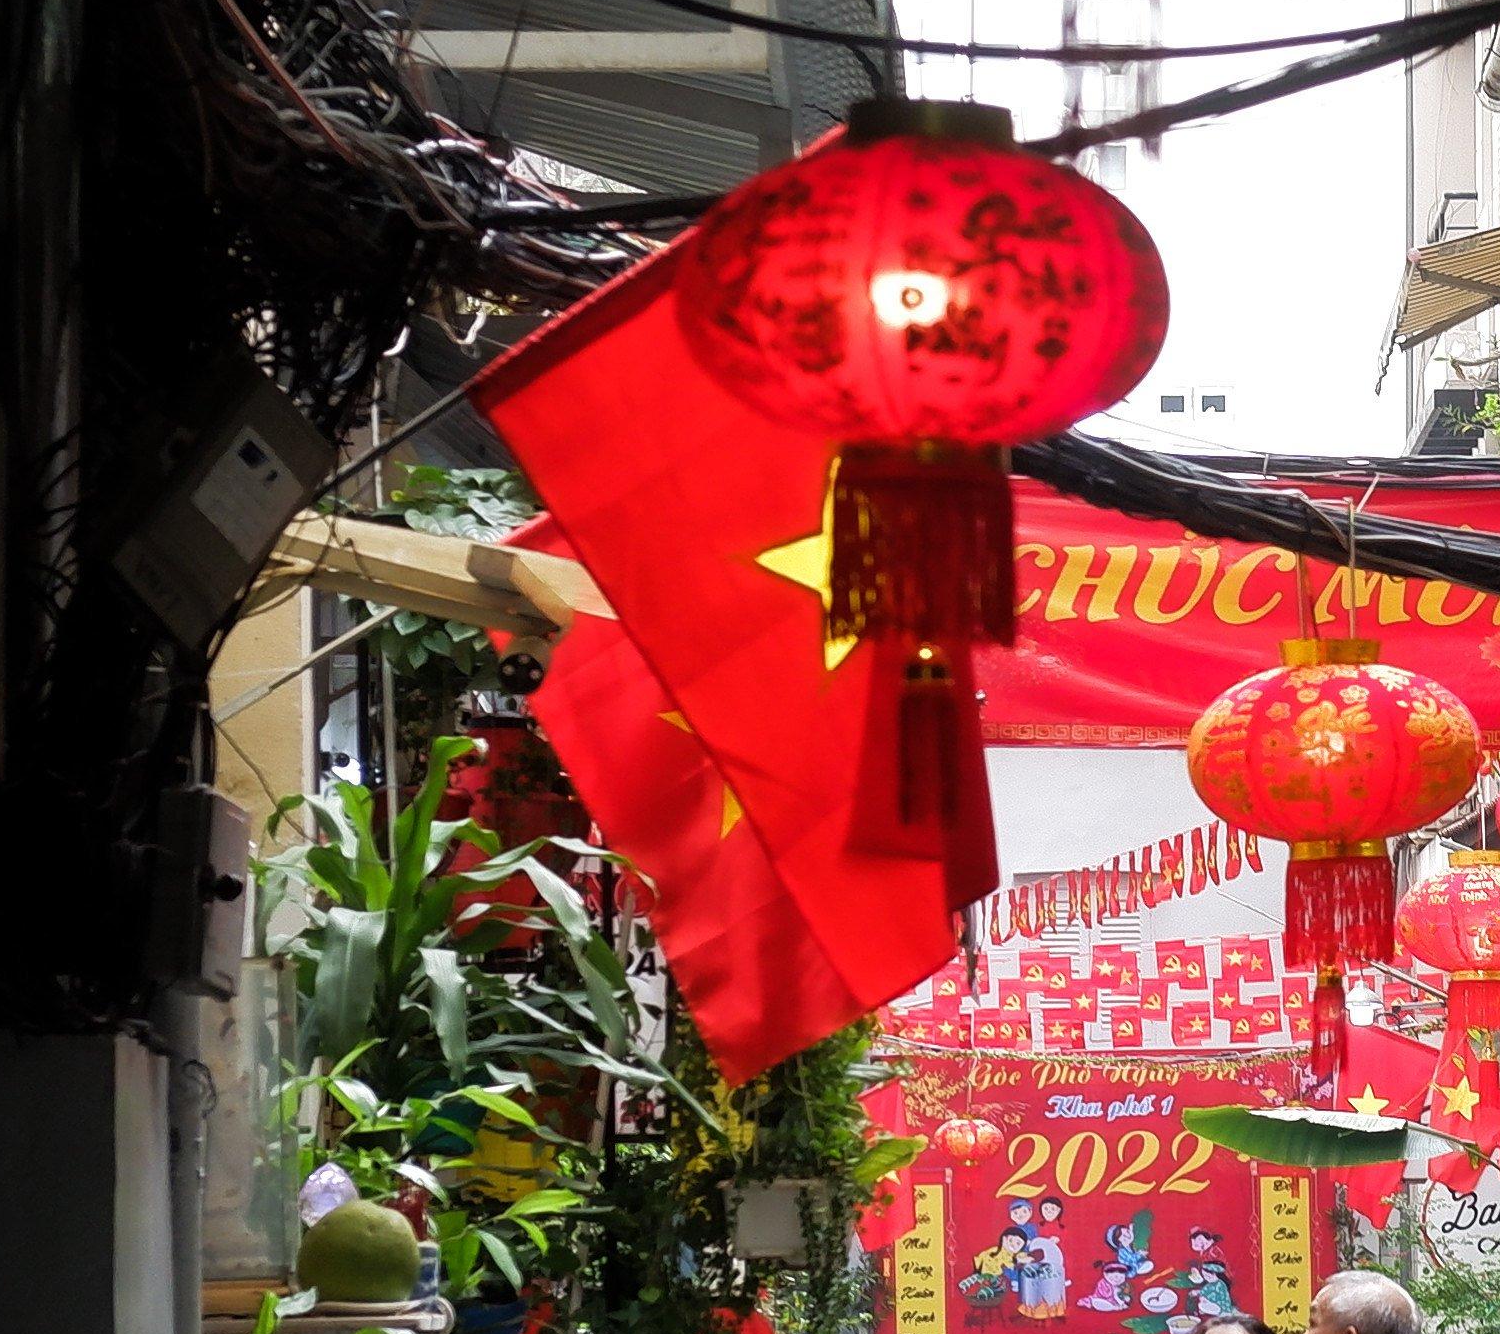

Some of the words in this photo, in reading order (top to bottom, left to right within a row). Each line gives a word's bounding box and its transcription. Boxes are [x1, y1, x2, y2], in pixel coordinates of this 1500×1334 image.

[1045, 1094, 1103, 1119] Khu
[1161, 1095, 1175, 1116] 1
[996, 1129, 1214, 1198] 2022
